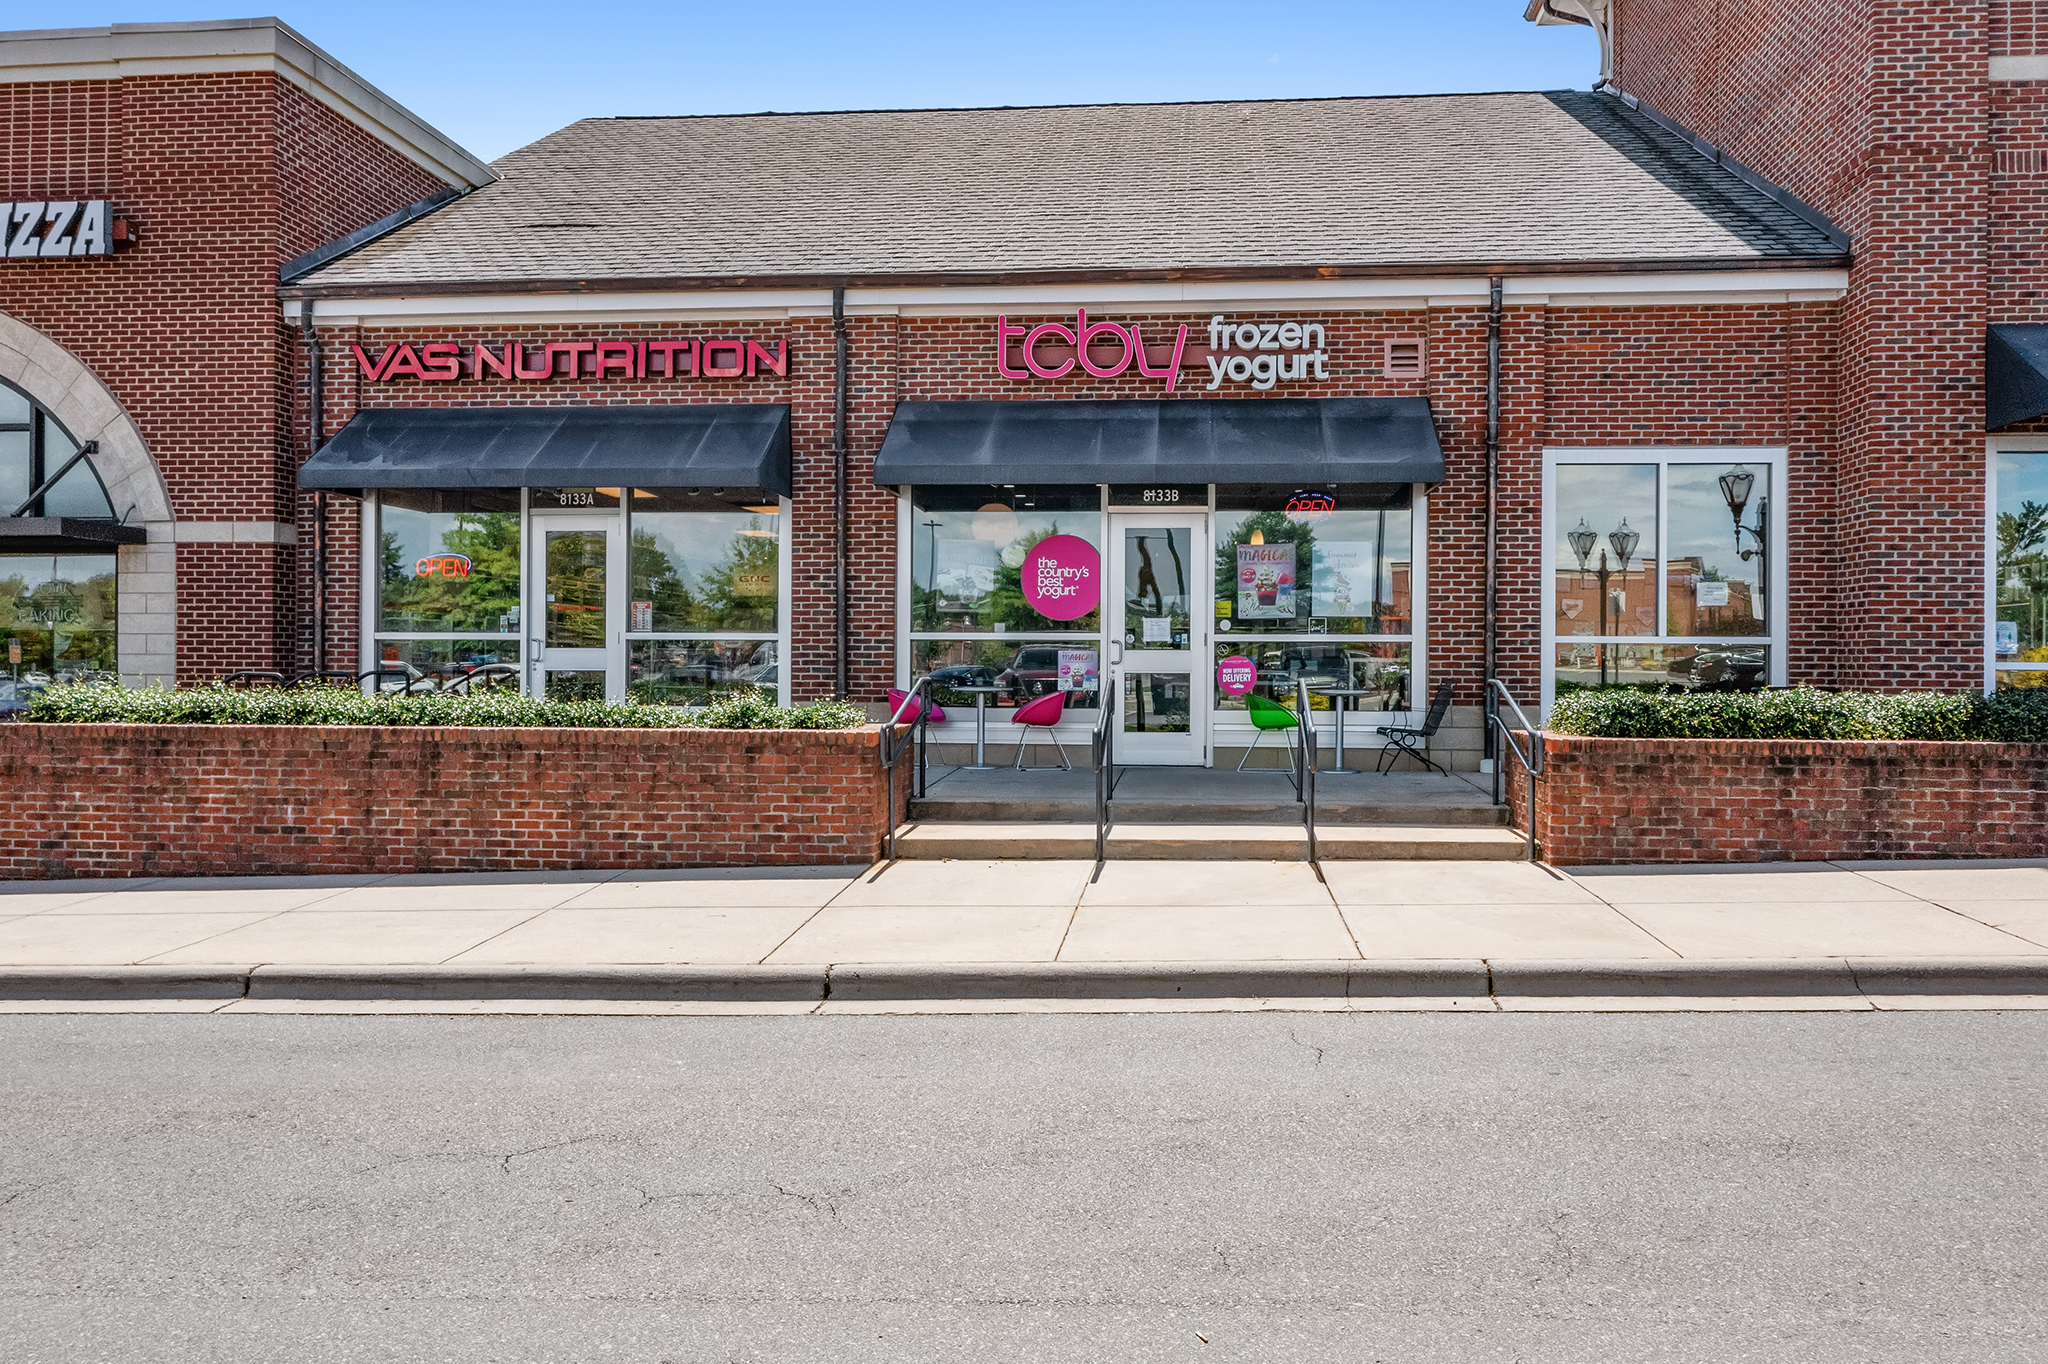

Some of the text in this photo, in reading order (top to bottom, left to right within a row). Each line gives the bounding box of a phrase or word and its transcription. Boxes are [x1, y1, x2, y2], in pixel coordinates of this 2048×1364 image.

[1207, 315, 1326, 350] frozen
[998, 307, 1187, 393] tcby
[351, 339, 790, 381] VAS NUTRITION
[1206, 348, 1329, 391] yogurt
[560, 493, 594, 505] 8133A
[1143, 489, 1179, 502] 8133B
[1285, 499, 1336, 517] OPEN
[415, 557, 468, 577] OPEN
[1037, 556, 1057, 568] the
[1037, 566, 1090, 581] country's
[1037, 576, 1064, 587] best
[1037, 585, 1076, 599] yogurt
[1222, 673, 1252, 682] DELIVERY
